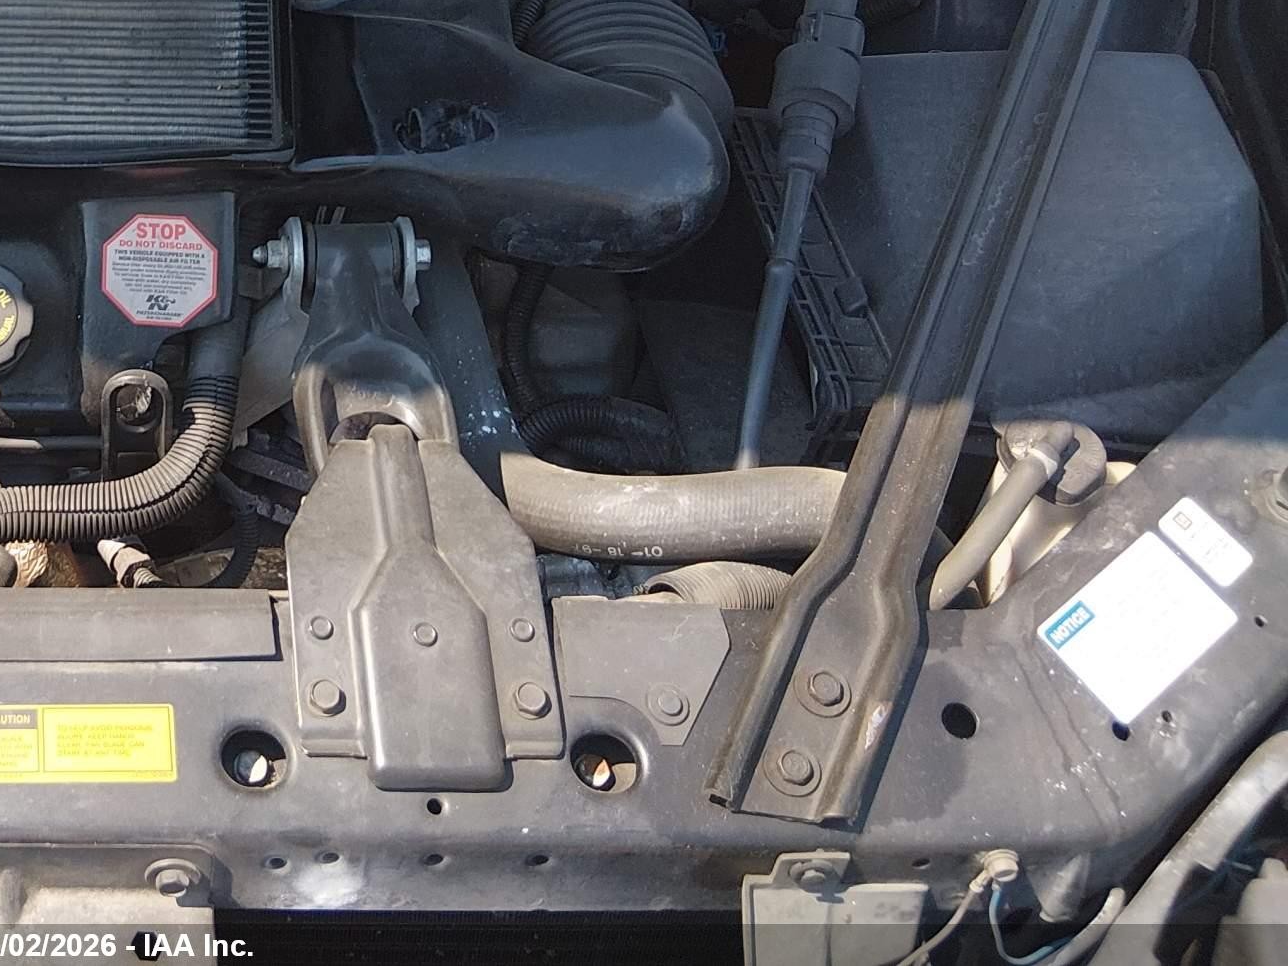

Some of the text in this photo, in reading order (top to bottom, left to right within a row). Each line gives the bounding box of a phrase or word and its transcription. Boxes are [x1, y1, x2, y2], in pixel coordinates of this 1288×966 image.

[136, 222, 186, 240] STOP
[135, 240, 156, 248] NOT
[159, 242, 203, 250] DISCARD
[1049, 605, 1091, 644] NOTICE
